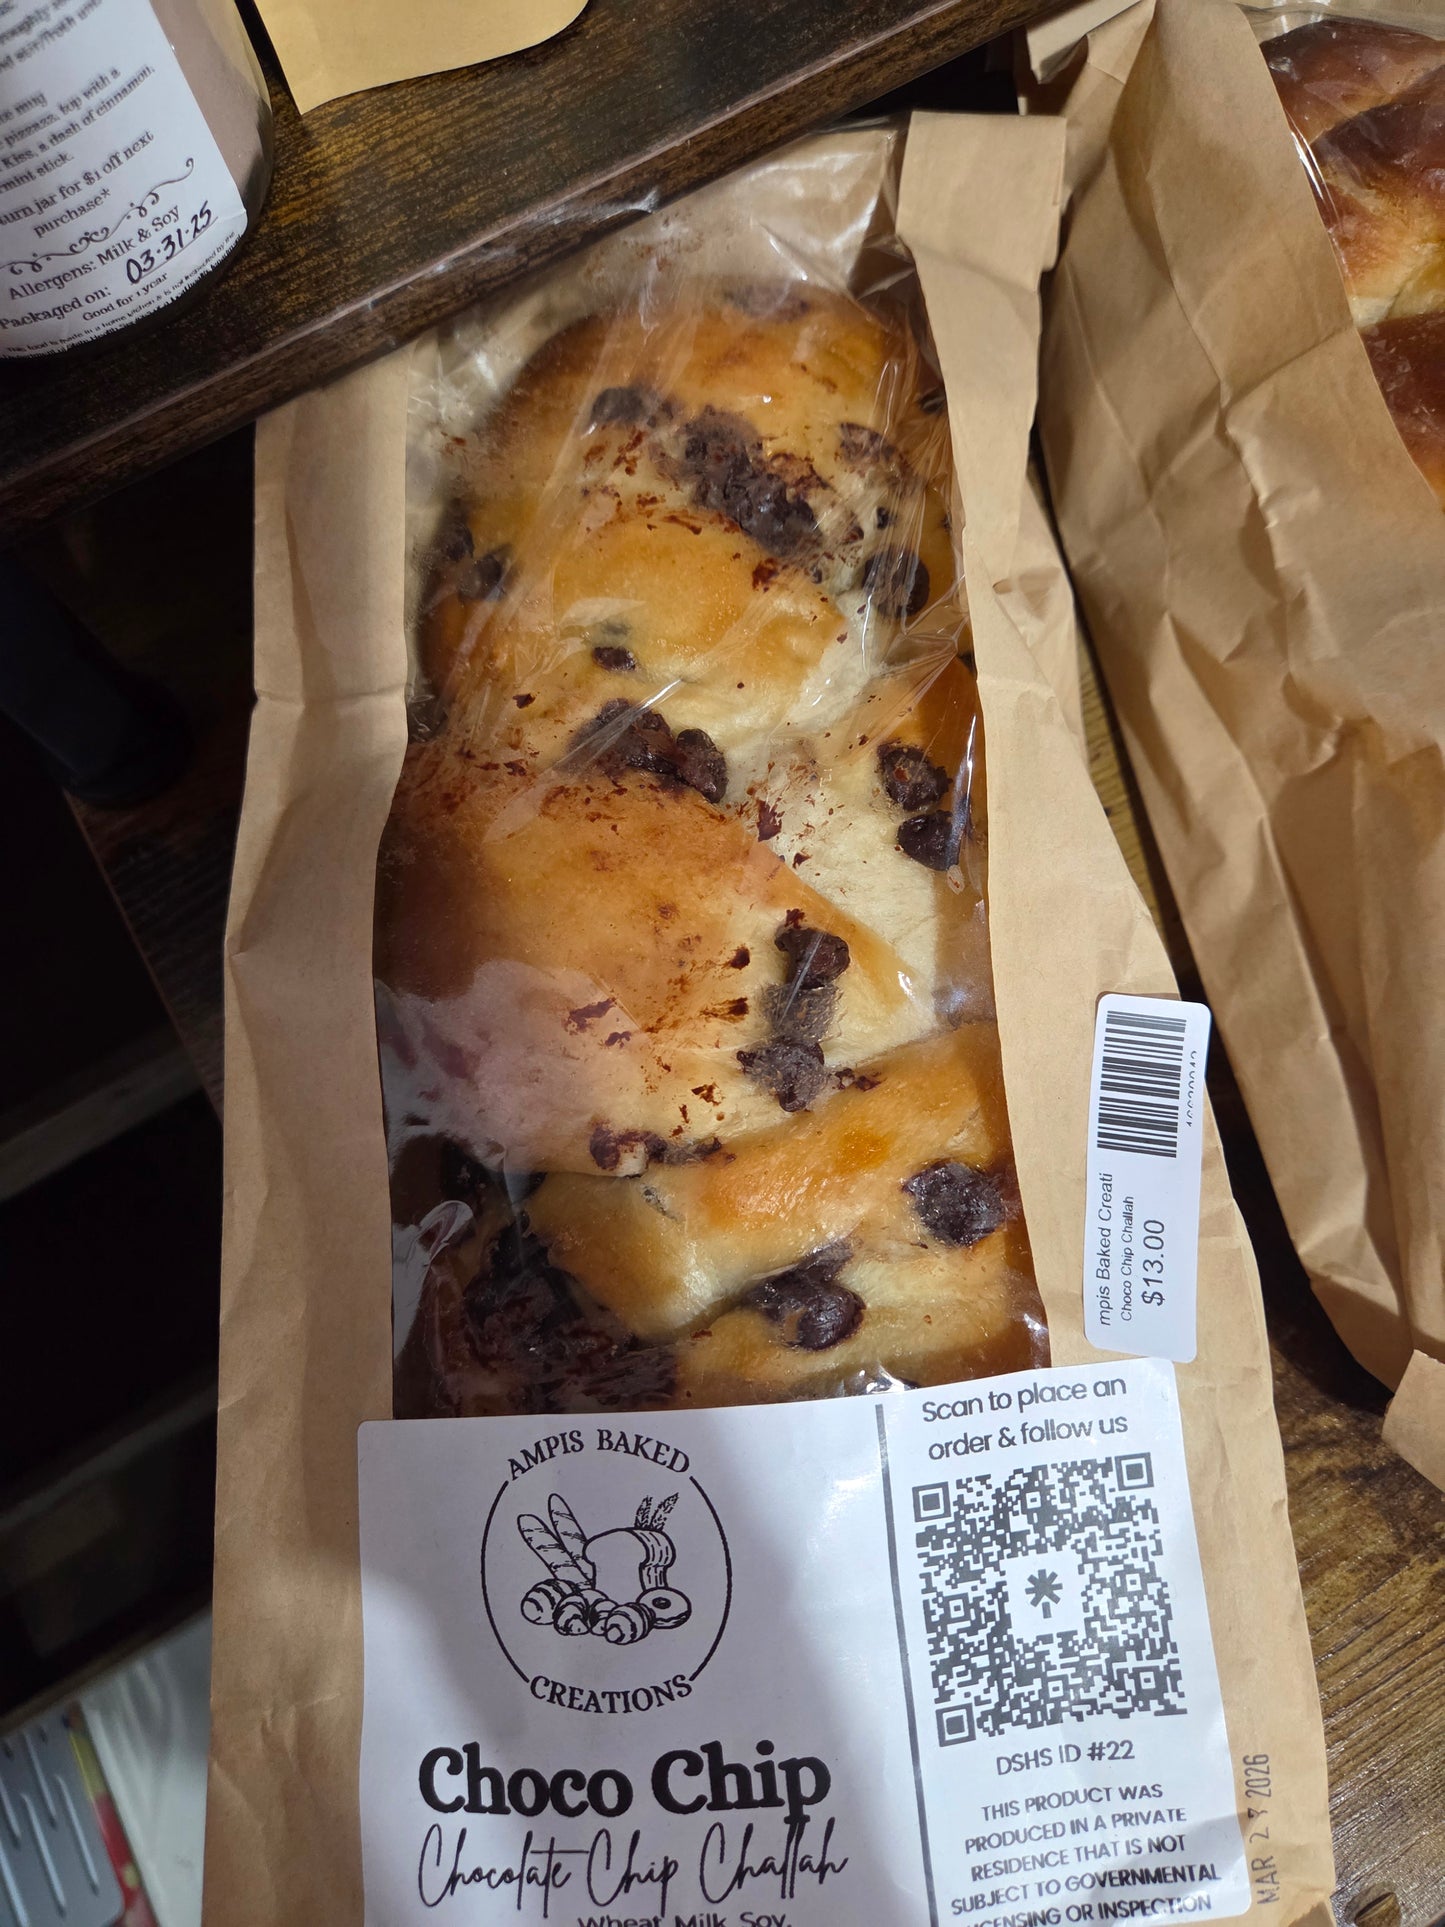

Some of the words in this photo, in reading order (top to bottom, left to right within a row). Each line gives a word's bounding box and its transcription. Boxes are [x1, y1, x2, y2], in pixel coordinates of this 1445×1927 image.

[59, 96, 82, 116] top
[83, 74, 111, 101] with
[110, 68, 121, 79] a
[49, 122, 81, 147] dash
[82, 108, 98, 126] of
[34, 195, 58, 215] jar
[58, 181, 82, 200] for
[83, 169, 102, 186] $1
[103, 151, 124, 174] off
[123, 130, 154, 161] next
[9, 261, 97, 300] Allergens:
[96, 237, 137, 265] Milk
[137, 228, 152, 243] &
[151, 205, 180, 232] Soy
[0, 297, 83, 329] Packaged
[85, 287, 111, 304] on:
[83, 303, 115, 321] Good
[116, 294, 133, 307] for
[142, 273, 168, 295] year
[1098, 1172, 1113, 1222] Creati
[1120, 1196, 1134, 1244] Challah
[1096, 1226, 1112, 1280] Baked
[1120, 1247, 1134, 1276] Chip
[1141, 1219, 1166, 1307] $13.00
[1096, 1285, 1113, 1326] mpis
[1120, 1280, 1132, 1321] Choco
[922, 1397, 983, 1422] Scan
[988, 1391, 1012, 1411] to
[1018, 1382, 1087, 1413] place
[1093, 1378, 1127, 1397] an
[507, 1430, 585, 1481] AMPIS
[597, 1428, 690, 1473] BAKED
[928, 1432, 992, 1460] order
[998, 1426, 1017, 1448] &
[1020, 1418, 1093, 1444] follow
[1099, 1416, 1128, 1435] us
[529, 1673, 693, 1714] CREATIONS
[418, 1741, 634, 1818] Choco
[651, 1739, 831, 1824] Chip
[996, 1748, 1053, 1776] DSHS
[1059, 1744, 1081, 1764] ID
[1086, 1739, 1135, 1761] #22
[1243, 1754, 1272, 1798] 2026
[981, 1800, 1020, 1822] THIS
[1025, 1787, 1113, 1813] PRODUCT
[1118, 1783, 1163, 1801] WAS
[965, 1821, 1066, 1855] PRODUCED
[1070, 1816, 1089, 1835] IN
[1093, 1814, 1107, 1831] A
[1111, 1808, 1187, 1829] PRIVATE
[418, 1823, 590, 1918] Chocolate
[587, 1827, 679, 1918] Chip
[700, 1816, 849, 1904] Challah
[970, 1850, 1069, 1882] RESIDENCE
[1073, 1841, 1120, 1863] THAT
[1125, 1837, 1143, 1856] IS
[1147, 1834, 1186, 1854] NOT
[1251, 1855, 1280, 1905] MAR
[951, 1883, 1029, 1916] SUBJECT
[1035, 1879, 1061, 1897] TO
[1064, 1863, 1222, 1893] GOVERNMENTAL
[966, 1907, 1061, 1927] ENSING
[1065, 1903, 1093, 1923] OR
[1097, 1894, 1212, 1921] INSPECTION
